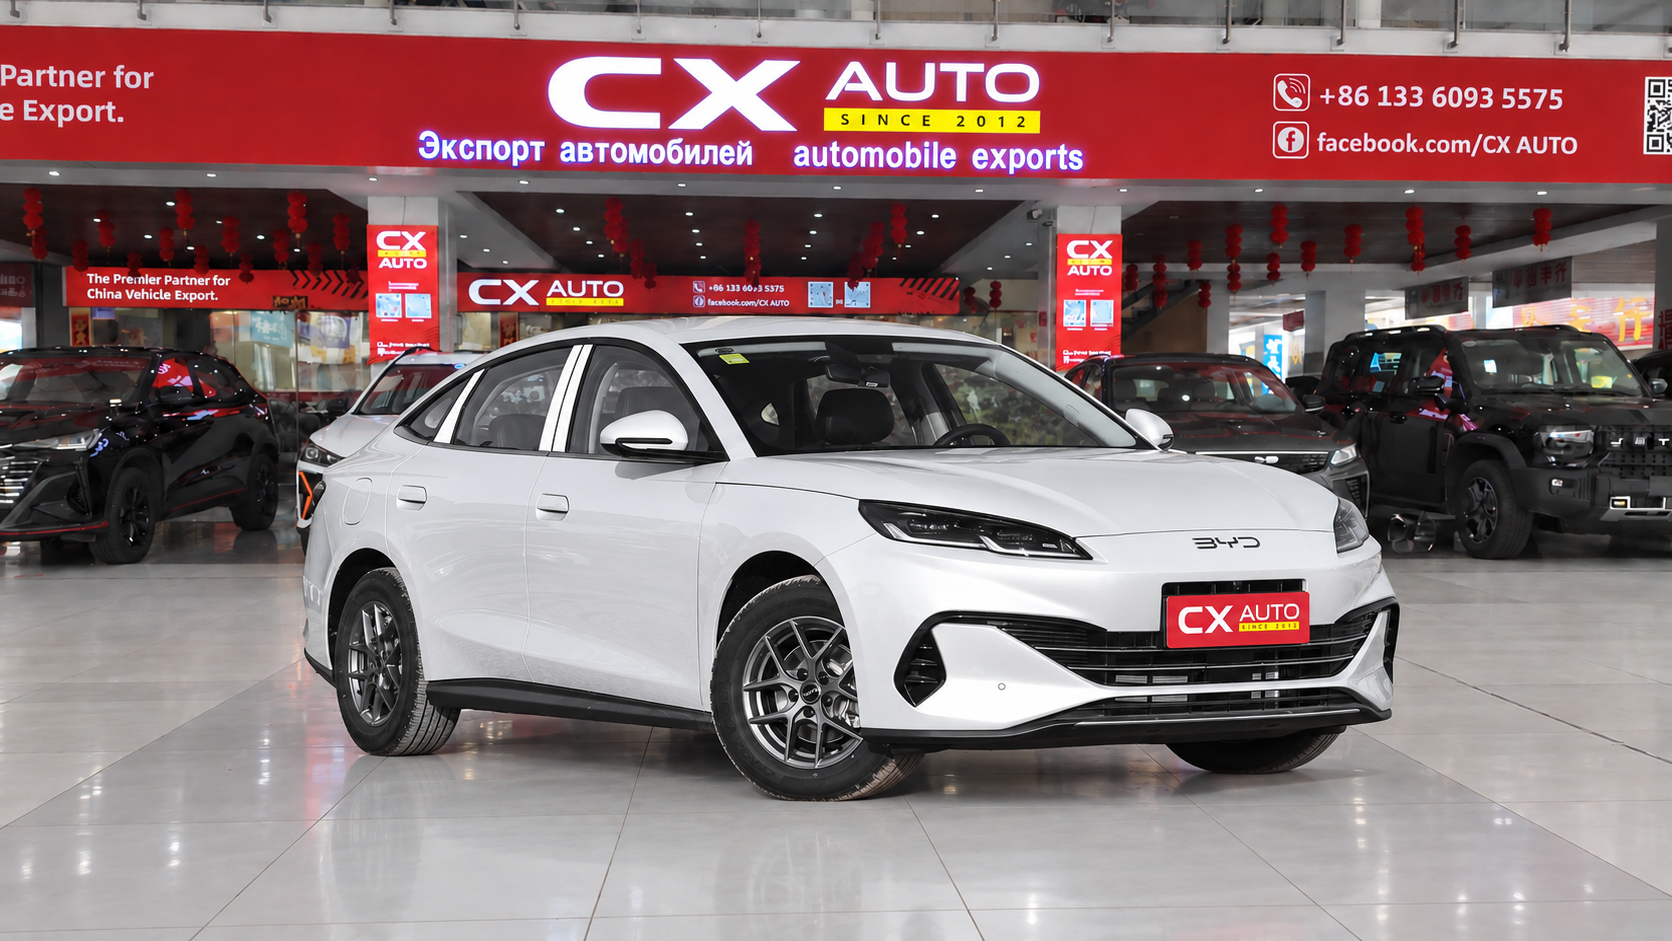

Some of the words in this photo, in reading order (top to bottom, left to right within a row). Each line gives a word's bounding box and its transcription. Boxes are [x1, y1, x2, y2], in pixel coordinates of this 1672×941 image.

[0, 64, 106, 88] Partner
[113, 65, 154, 89] for
[547, 56, 801, 132] CX
[825, 61, 1040, 103] AUTO
[1319, 85, 1370, 107] +86
[1377, 86, 1424, 107] 133
[1431, 87, 1494, 108] 6093
[1501, 88, 1564, 110] 5575
[23, 99, 125, 128] Export.
[841, 113, 931, 127] SINCE
[956, 115, 1026, 128] 2012
[418, 130, 546, 167] Экспорт
[559, 138, 754, 166] автомобилей
[1316, 132, 1511, 157] facebook.com/CX
[1515, 137, 1578, 154] AUTO
[793, 141, 957, 169] automobile
[971, 144, 1084, 174] exports
[376, 230, 427, 251] CX
[1066, 240, 1114, 259] CX
[378, 257, 428, 269] AUTO
[1067, 265, 1113, 276] AUTO
[86, 273, 110, 284] The
[164, 275, 210, 286] Partner
[212, 275, 231, 286] for
[726, 284, 740, 292] 133
[87, 288, 122, 299] China
[125, 289, 171, 300] Vehicle
[175, 290, 219, 303] Export.
[468, 279, 540, 306] CX
[546, 280, 624, 298] AUTO
[1192, 536, 1261, 549] BYD
[1178, 605, 1234, 634] CX
[1239, 603, 1300, 622] AUTO
